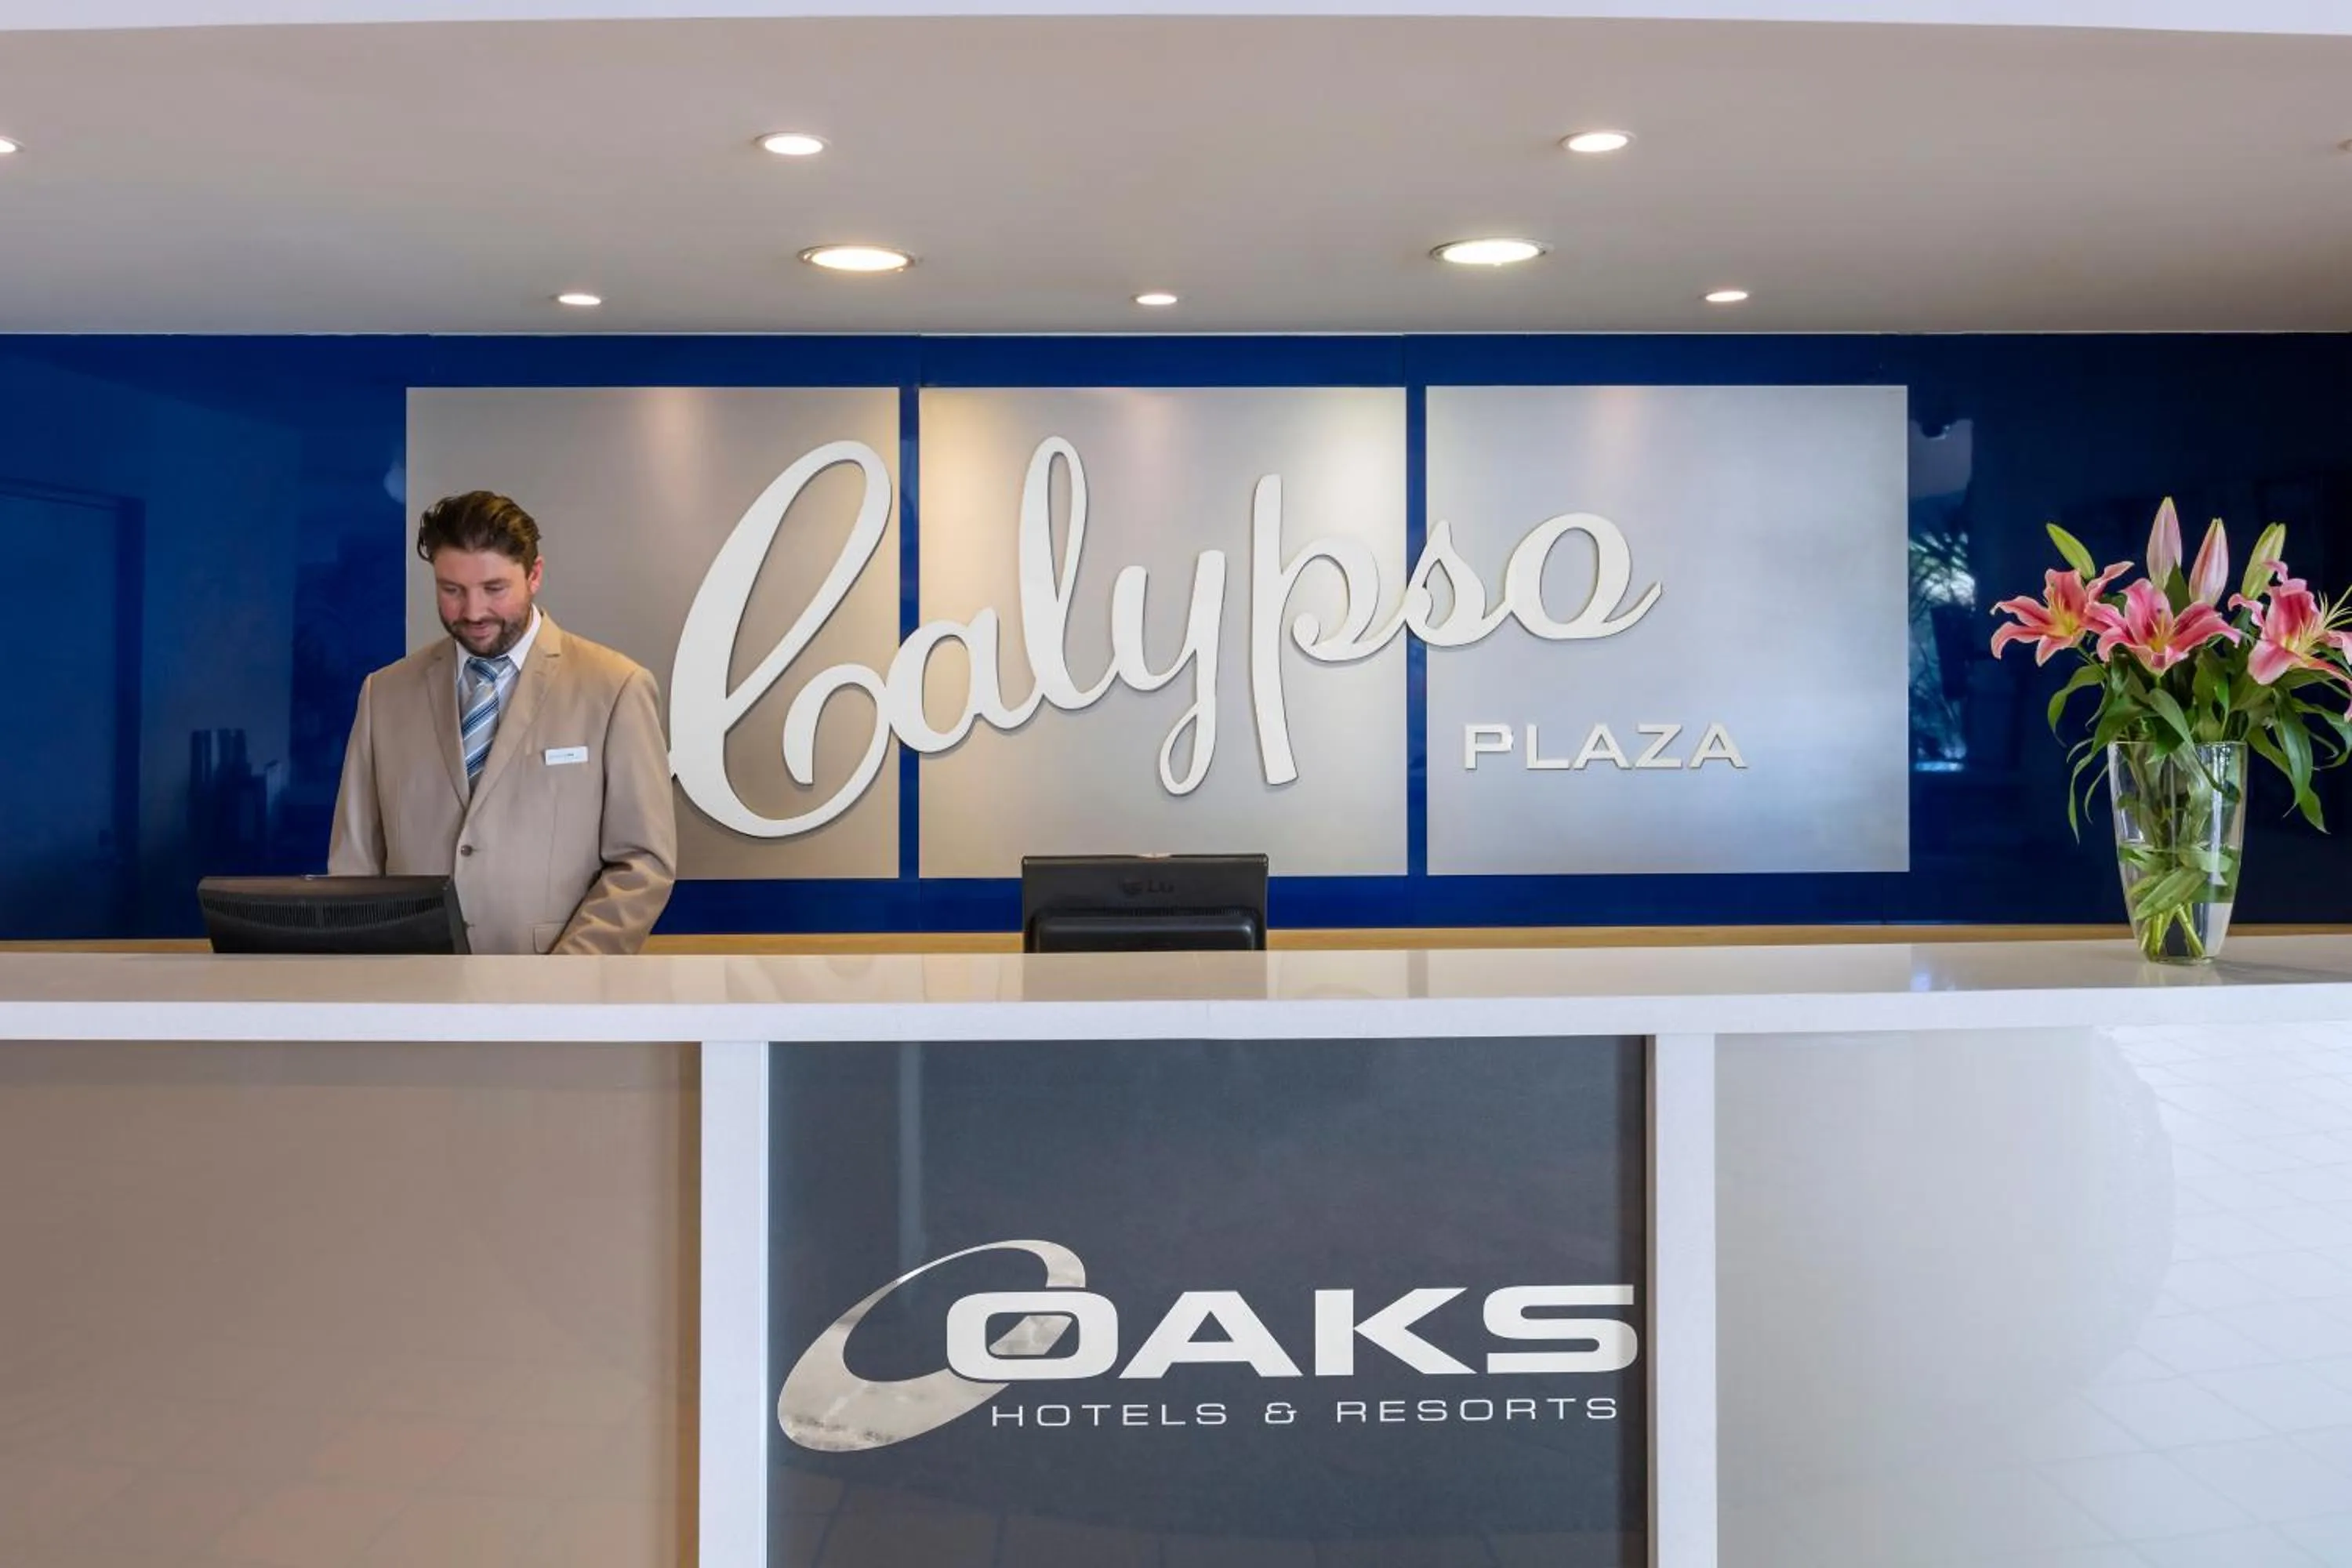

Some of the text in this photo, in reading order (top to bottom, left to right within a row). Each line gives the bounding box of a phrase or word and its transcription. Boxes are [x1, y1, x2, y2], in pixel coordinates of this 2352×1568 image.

[669, 437, 1661, 837] Calypso
[1464, 724, 1747, 770] PLAZA
[946, 1284, 1637, 1381] OAKS
[992, 1396, 1618, 1427] HOTELS & RESORTS
